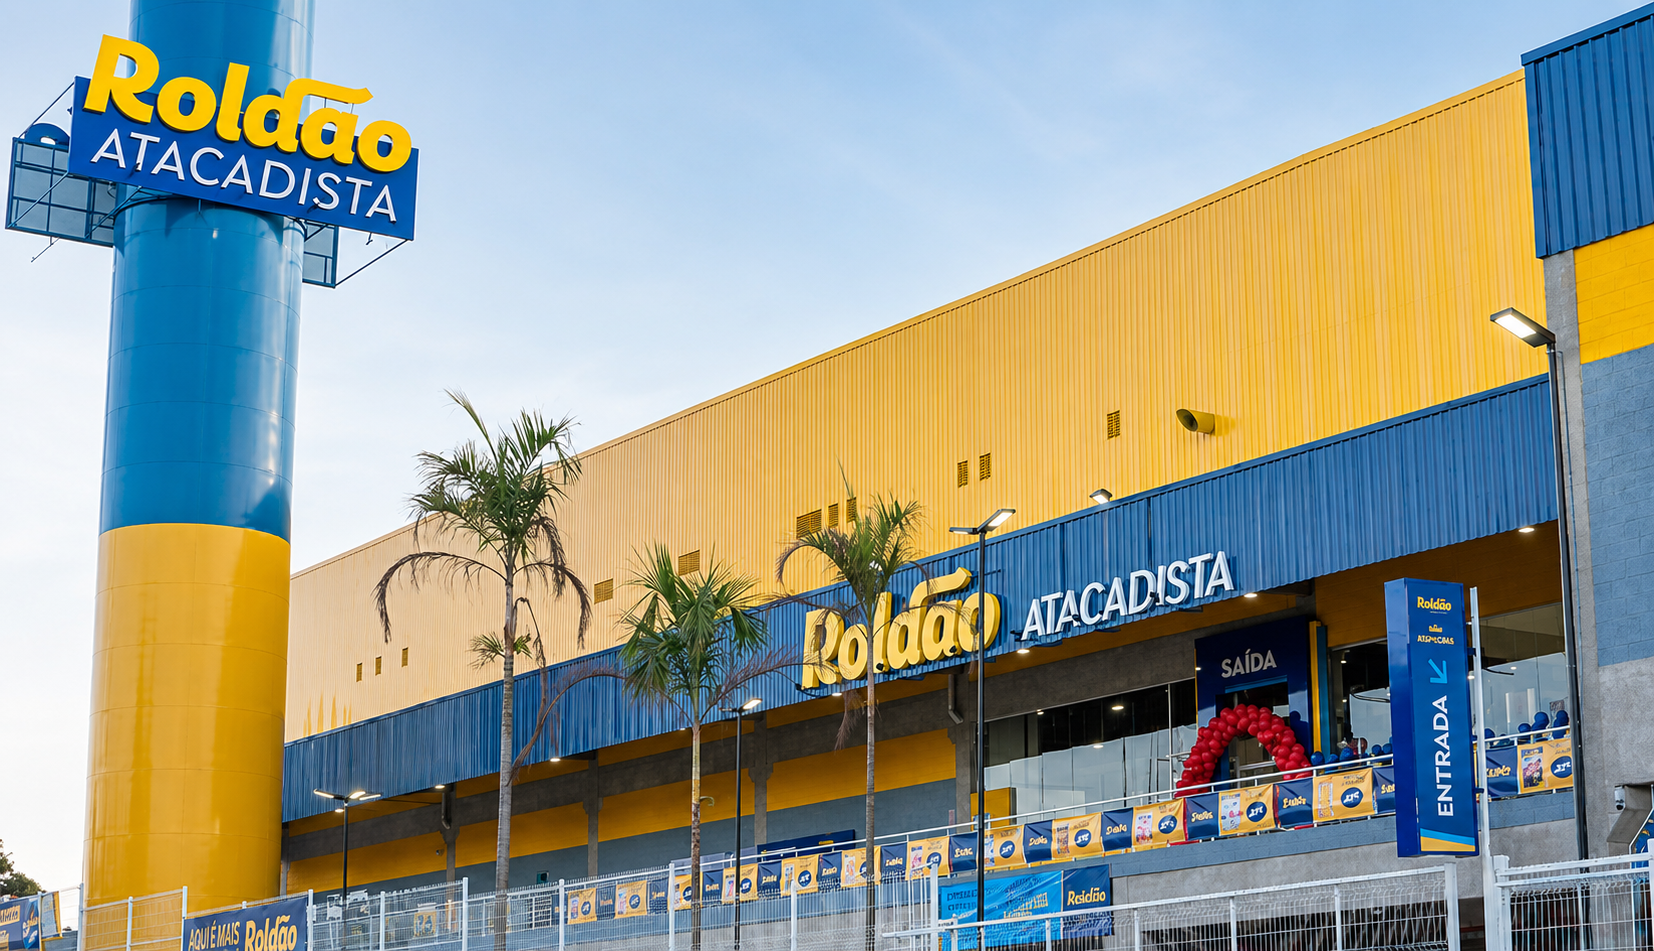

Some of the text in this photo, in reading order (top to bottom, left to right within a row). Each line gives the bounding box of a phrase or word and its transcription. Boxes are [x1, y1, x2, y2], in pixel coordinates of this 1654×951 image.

[83, 34, 412, 173] Roldão
[90, 128, 397, 223] ATACADISTA
[801, 551, 1235, 690] Roldão ATACADISTA
[1417, 596, 1452, 611] Roldão
[1221, 648, 1278, 678] SAÍDA
[1432, 695, 1454, 816] ENTRADA
[188, 919, 240, 951] AQUI É MAIS
[244, 914, 298, 951] Roldão
